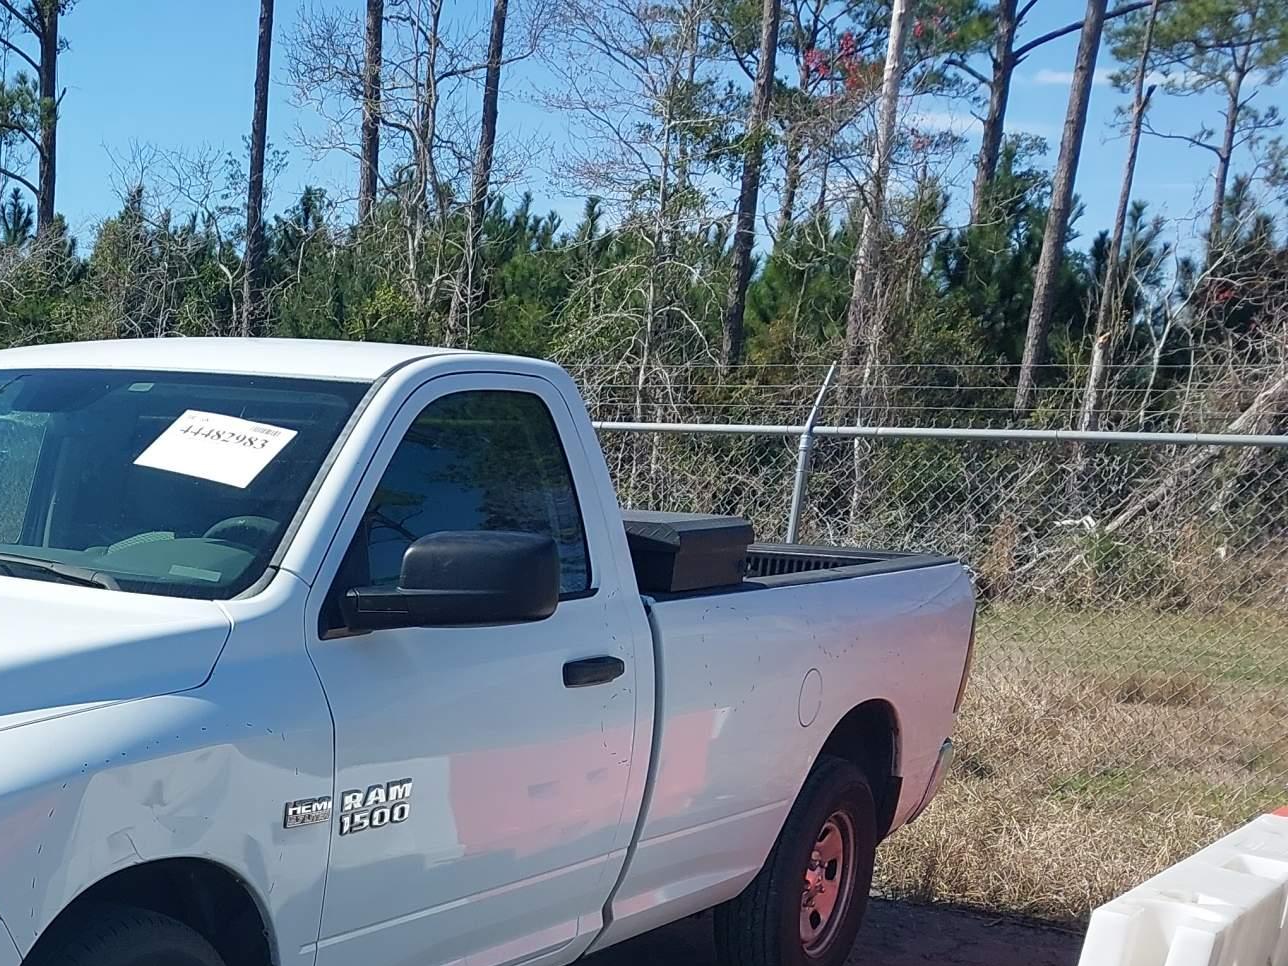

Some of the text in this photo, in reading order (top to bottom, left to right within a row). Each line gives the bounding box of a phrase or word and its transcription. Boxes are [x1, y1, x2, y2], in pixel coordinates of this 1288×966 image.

[179, 424, 269, 450] 44482983
[287, 797, 332, 816] HEMI
[341, 779, 413, 812] RAM
[340, 801, 411, 836] 1500
